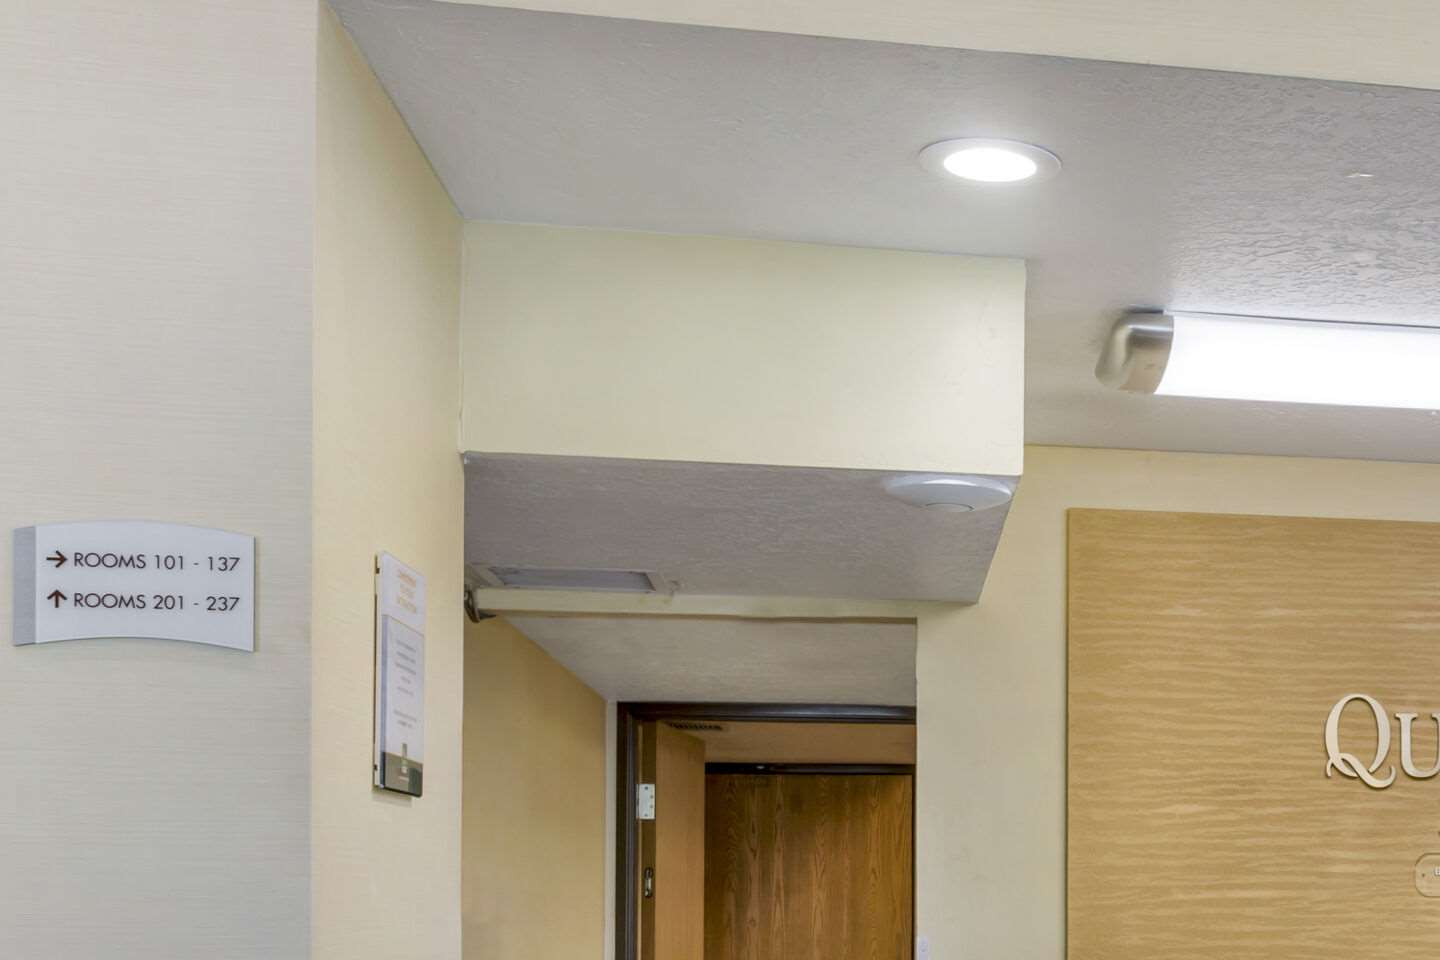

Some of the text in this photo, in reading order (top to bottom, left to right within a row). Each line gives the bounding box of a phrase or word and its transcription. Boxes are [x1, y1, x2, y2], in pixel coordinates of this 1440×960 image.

[73, 552, 147, 570] ROOMS
[154, 554, 185, 570] 101
[207, 556, 241, 572] 137
[73, 592, 147, 609] ROOMS
[153, 594, 185, 610] 201
[206, 596, 241, 612] 237
